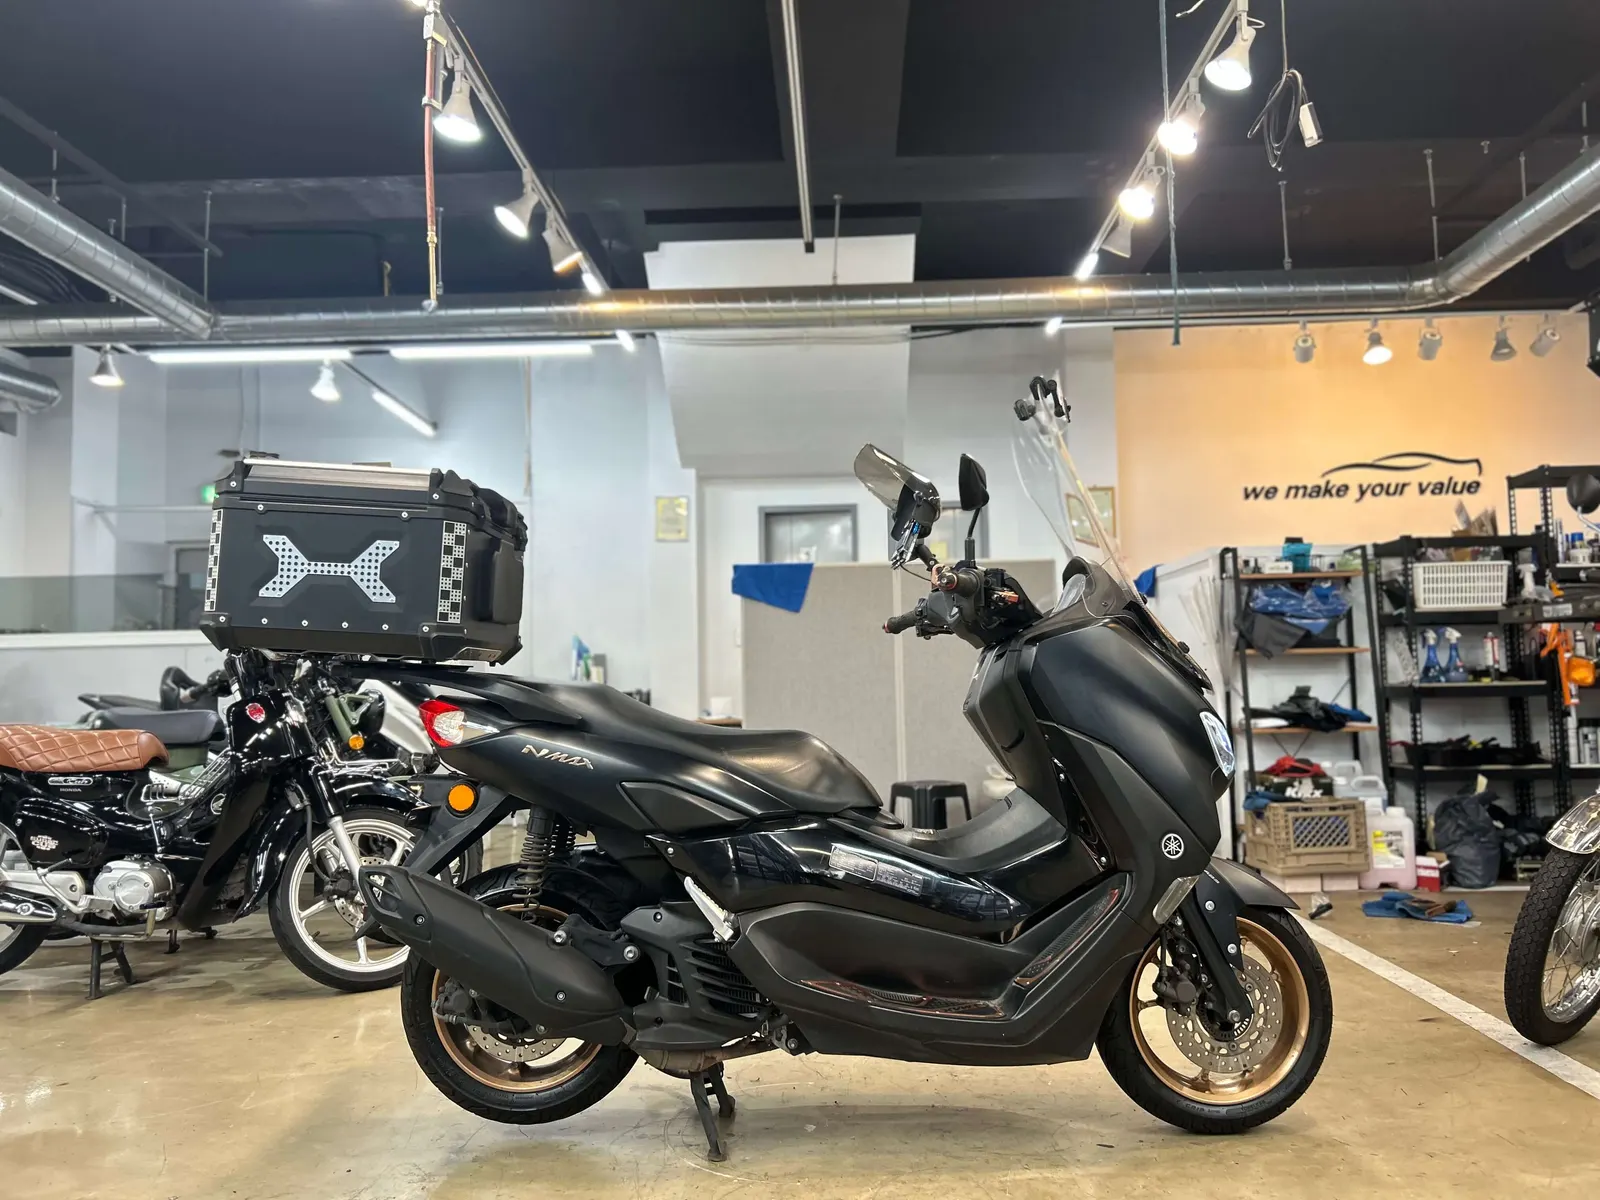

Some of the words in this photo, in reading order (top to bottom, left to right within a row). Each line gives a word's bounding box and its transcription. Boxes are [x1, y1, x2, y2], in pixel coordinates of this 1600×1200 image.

[1243, 485, 1278, 500] we
[1285, 479, 1349, 499] make
[1355, 481, 1410, 503] your
[1418, 476, 1481, 496] value
